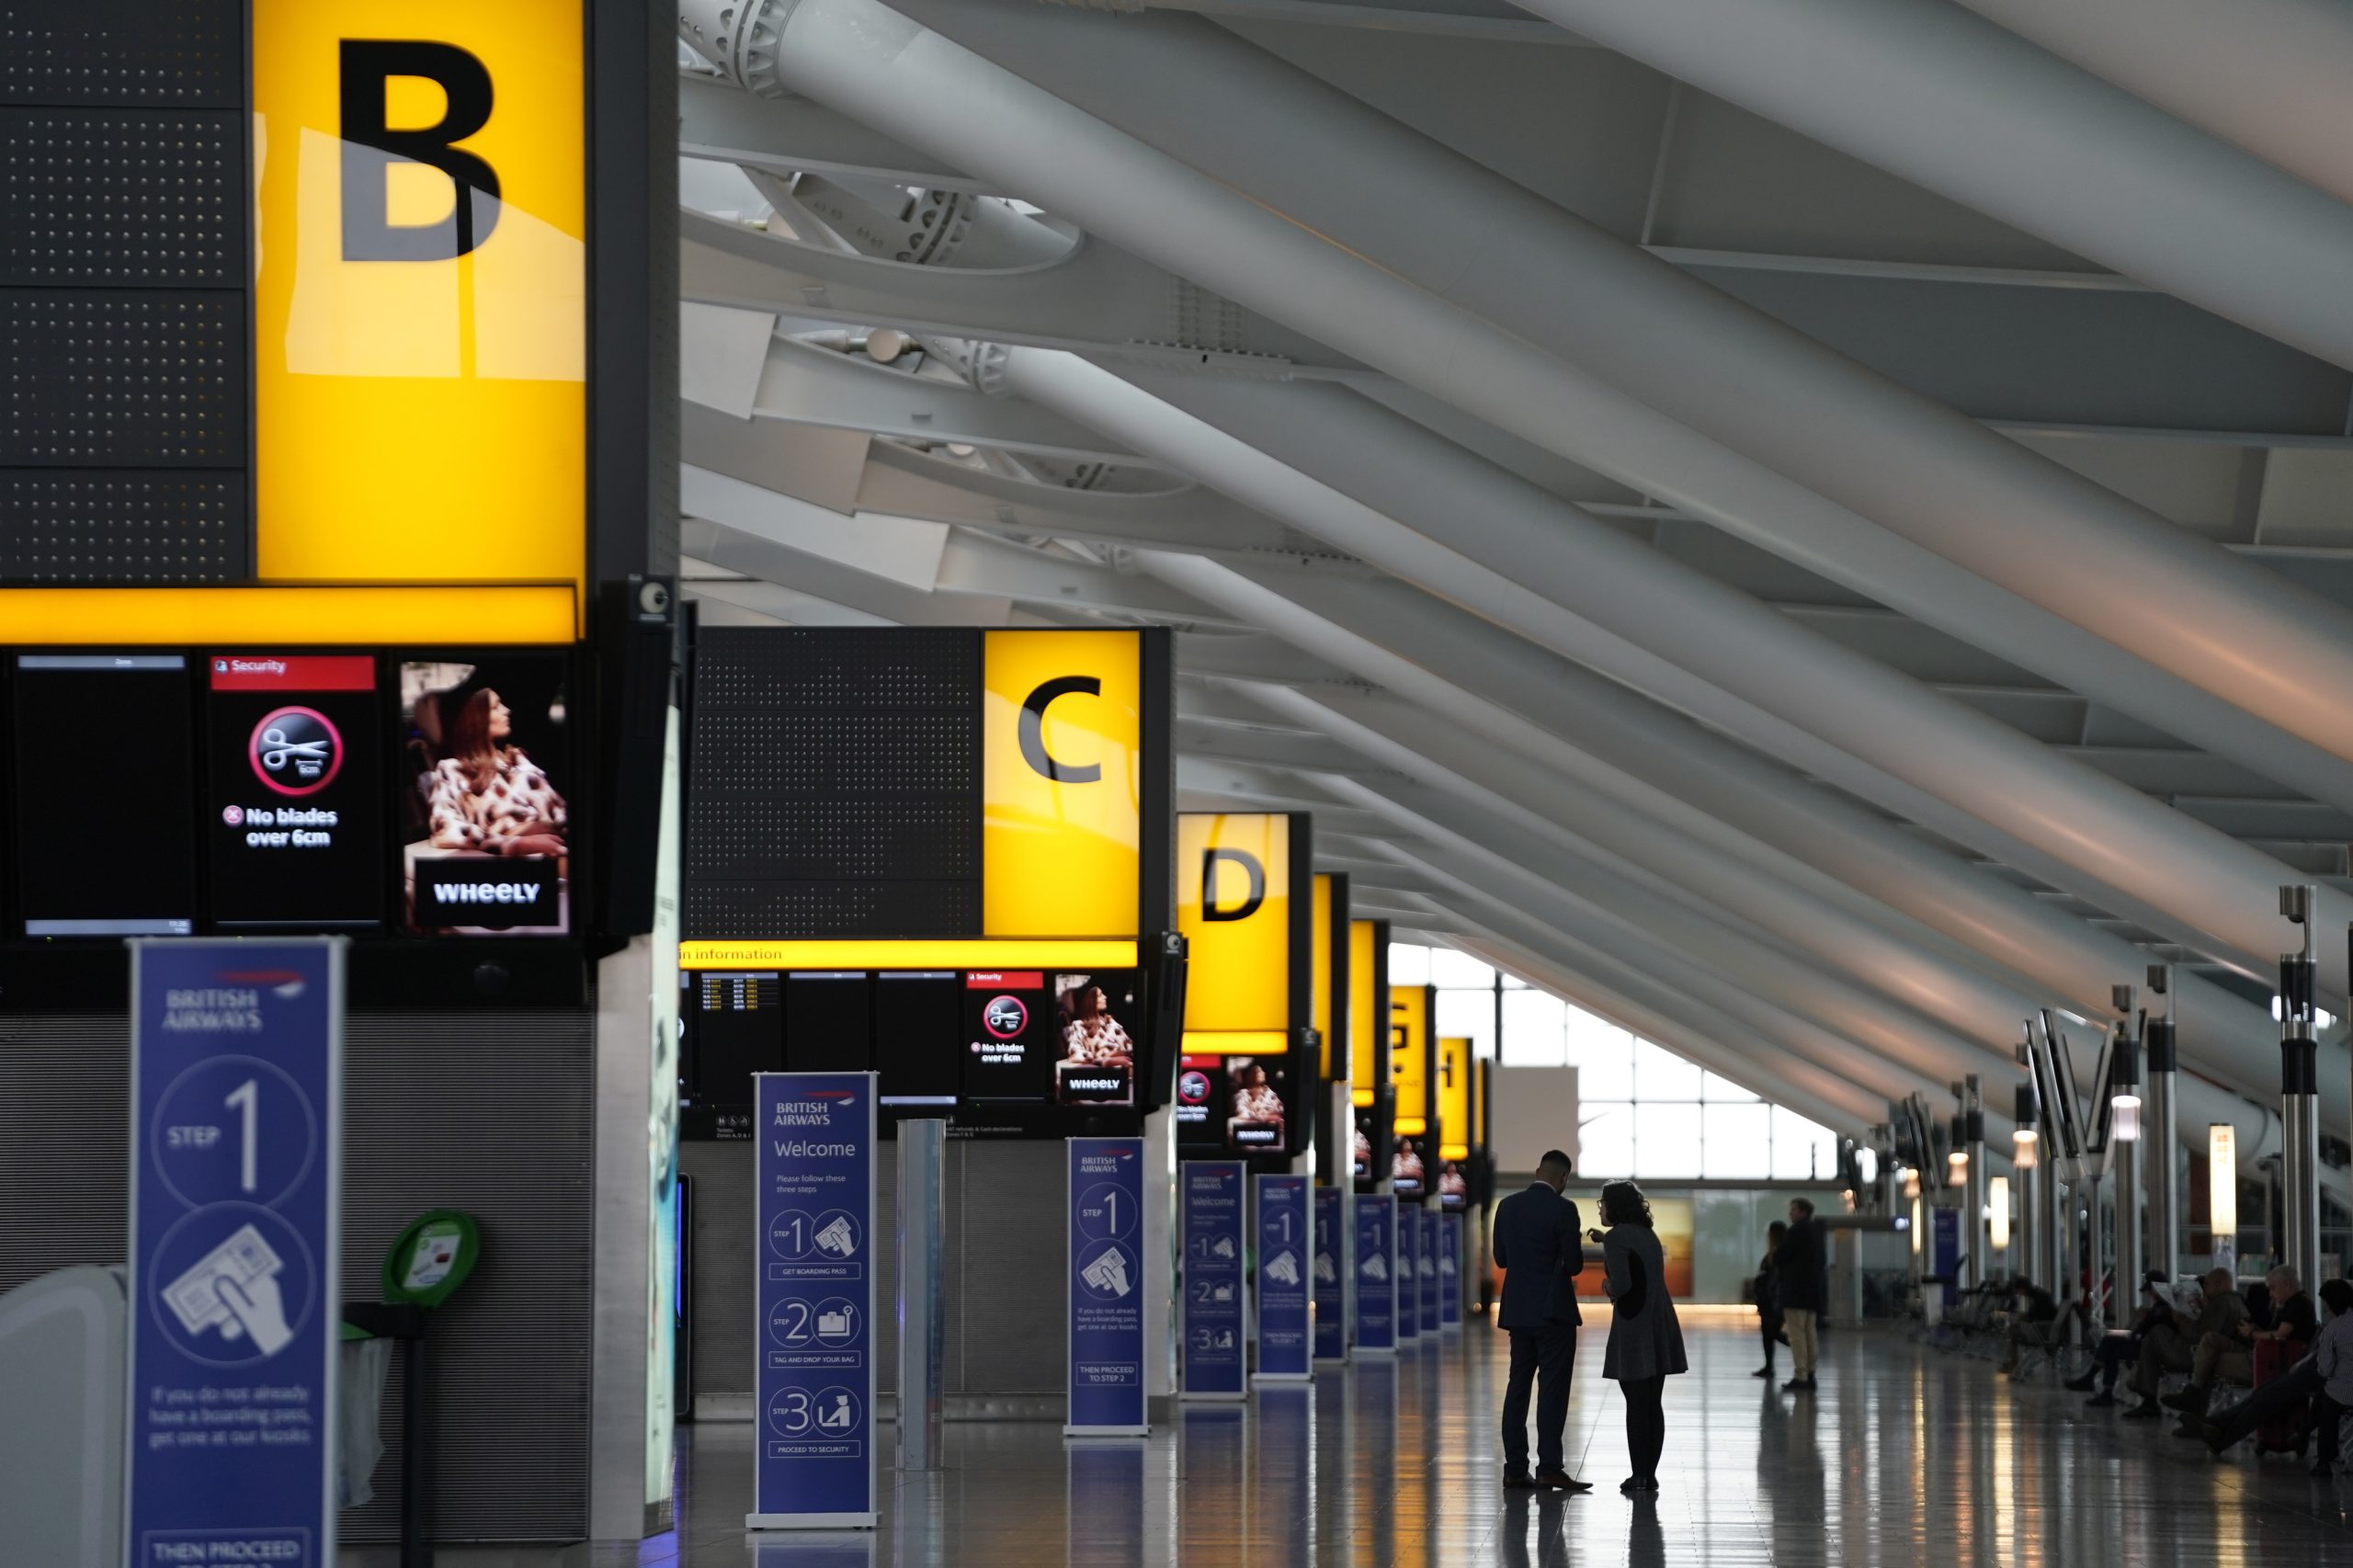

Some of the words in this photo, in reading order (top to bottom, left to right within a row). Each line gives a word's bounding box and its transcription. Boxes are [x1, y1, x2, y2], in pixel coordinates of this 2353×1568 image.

[338, 37, 501, 263] B
[232, 659, 287, 676] Security
[1017, 675, 1101, 784] C
[245, 808, 275, 826] No
[277, 807, 338, 826] blades
[245, 831, 290, 846] over
[291, 828, 331, 846] 6cm
[1202, 847, 1265, 922] D
[696, 949, 782, 960] information
[976, 972, 1002, 982] Security
[166, 988, 258, 1008] BRITISH
[161, 1009, 263, 1030] AIRWAYS
[982, 1043, 995, 1053] No
[996, 1042, 1025, 1053] blades
[981, 1053, 1002, 1063] over
[1004, 1051, 1022, 1062] 6cm
[777, 1103, 828, 1113] BRITISH
[774, 1114, 830, 1126] AIRWAYS
[167, 1126, 221, 1146] STEP
[224, 1078, 257, 1192] 1
[774, 1140, 856, 1157] Welcome
[1080, 1165, 1118, 1173] AIRWAYS
[1082, 1157, 1116, 1165] BRITISH
[777, 1175, 800, 1183] Please
[801, 1174, 824, 1183] follow
[825, 1174, 846, 1183] these
[777, 1186, 796, 1194] three
[798, 1187, 817, 1195] steps
[1192, 1197, 1235, 1206] Welcome
[1083, 1209, 1103, 1217] STEP
[1104, 1191, 1117, 1234] 1
[774, 1230, 790, 1238] STEP
[790, 1218, 801, 1253] 1
[1198, 1282, 1211, 1301] 2
[786, 1302, 809, 1339] 2
[1198, 1330, 1211, 1350] 3
[773, 1407, 789, 1415] STEP
[786, 1392, 809, 1430] 3
[153, 1542, 207, 1562] THEN
[208, 1540, 301, 1561] PROCEED
